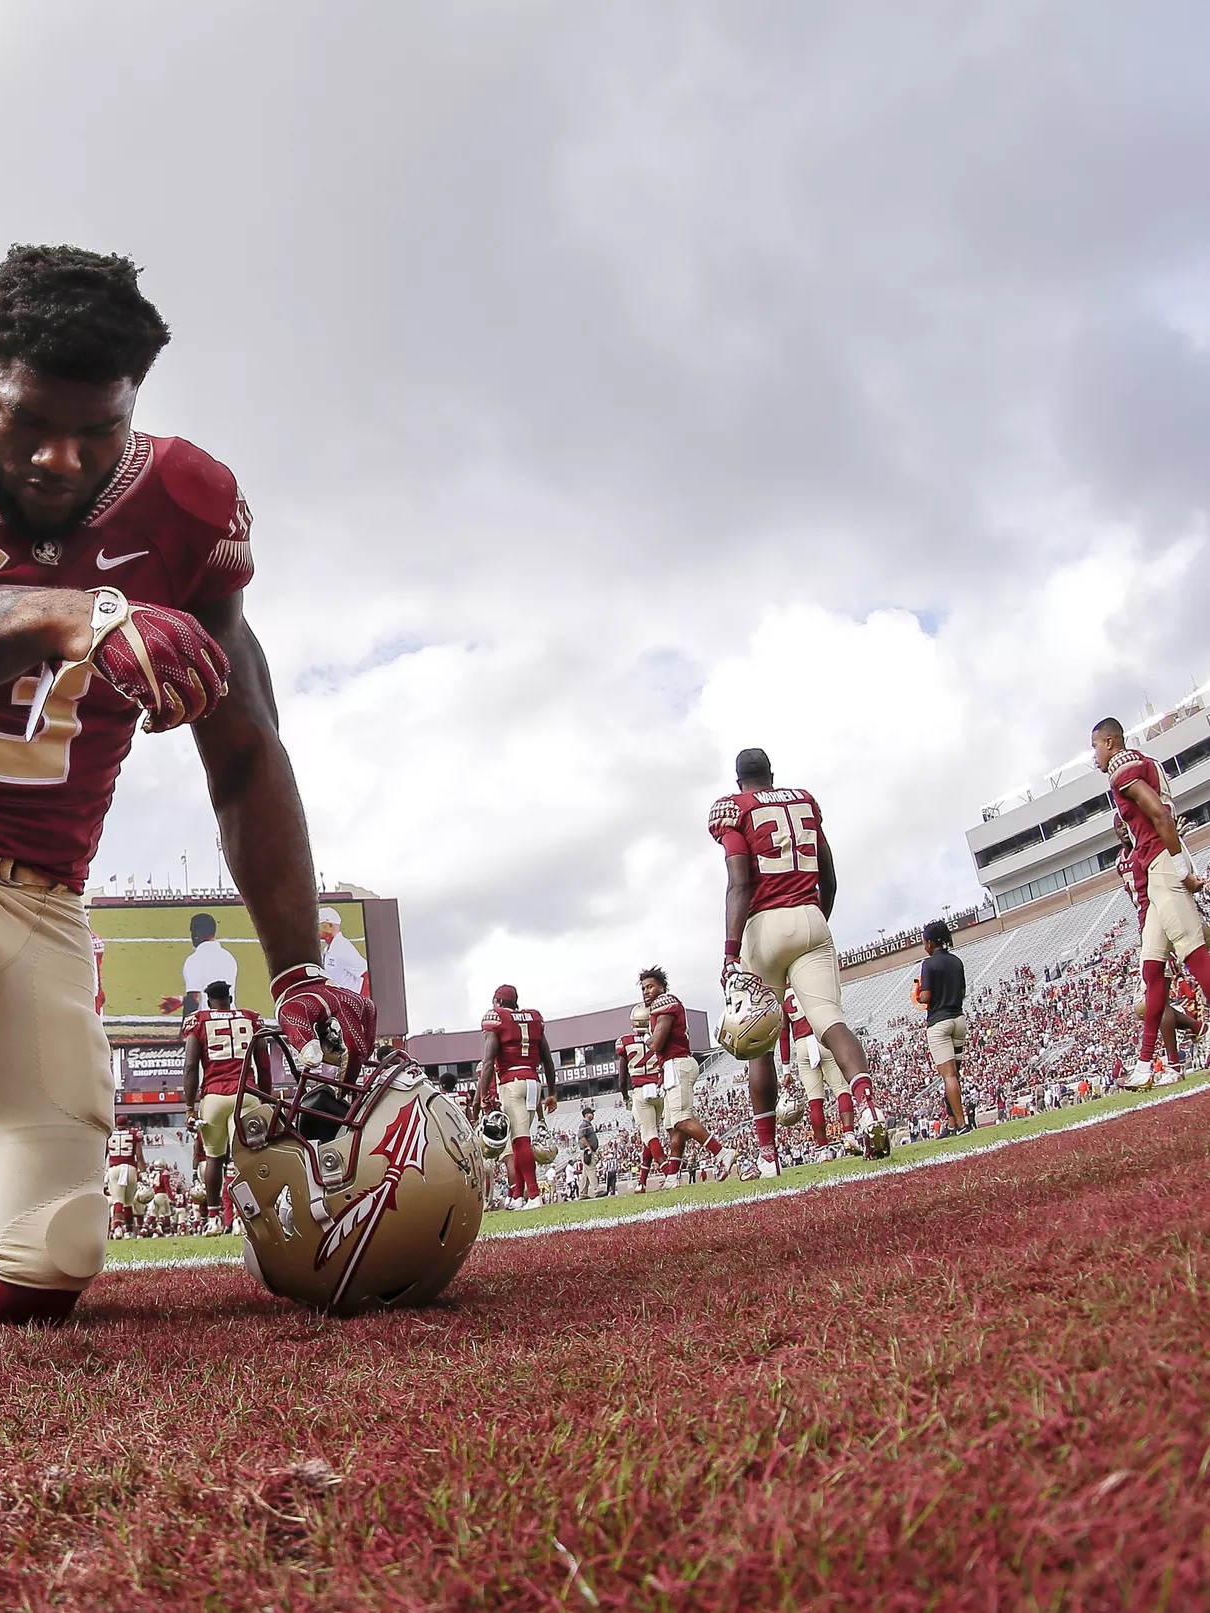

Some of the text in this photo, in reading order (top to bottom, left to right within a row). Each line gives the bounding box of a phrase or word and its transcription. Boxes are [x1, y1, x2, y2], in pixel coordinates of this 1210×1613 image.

[753, 790, 796, 803] WARNER
[751, 803, 819, 873] 35
[124, 888, 236, 901] FLORIDA STATE
[840, 940, 907, 968] FLORIDA STATE
[511, 1012, 534, 1022] TAYLOR
[205, 1019, 254, 1061] 58
[518, 1023, 530, 1057] 1
[563, 1067, 590, 1081] 1993,
[593, 1062, 619, 1077] 1999,
[108, 1134, 134, 1156] 95
